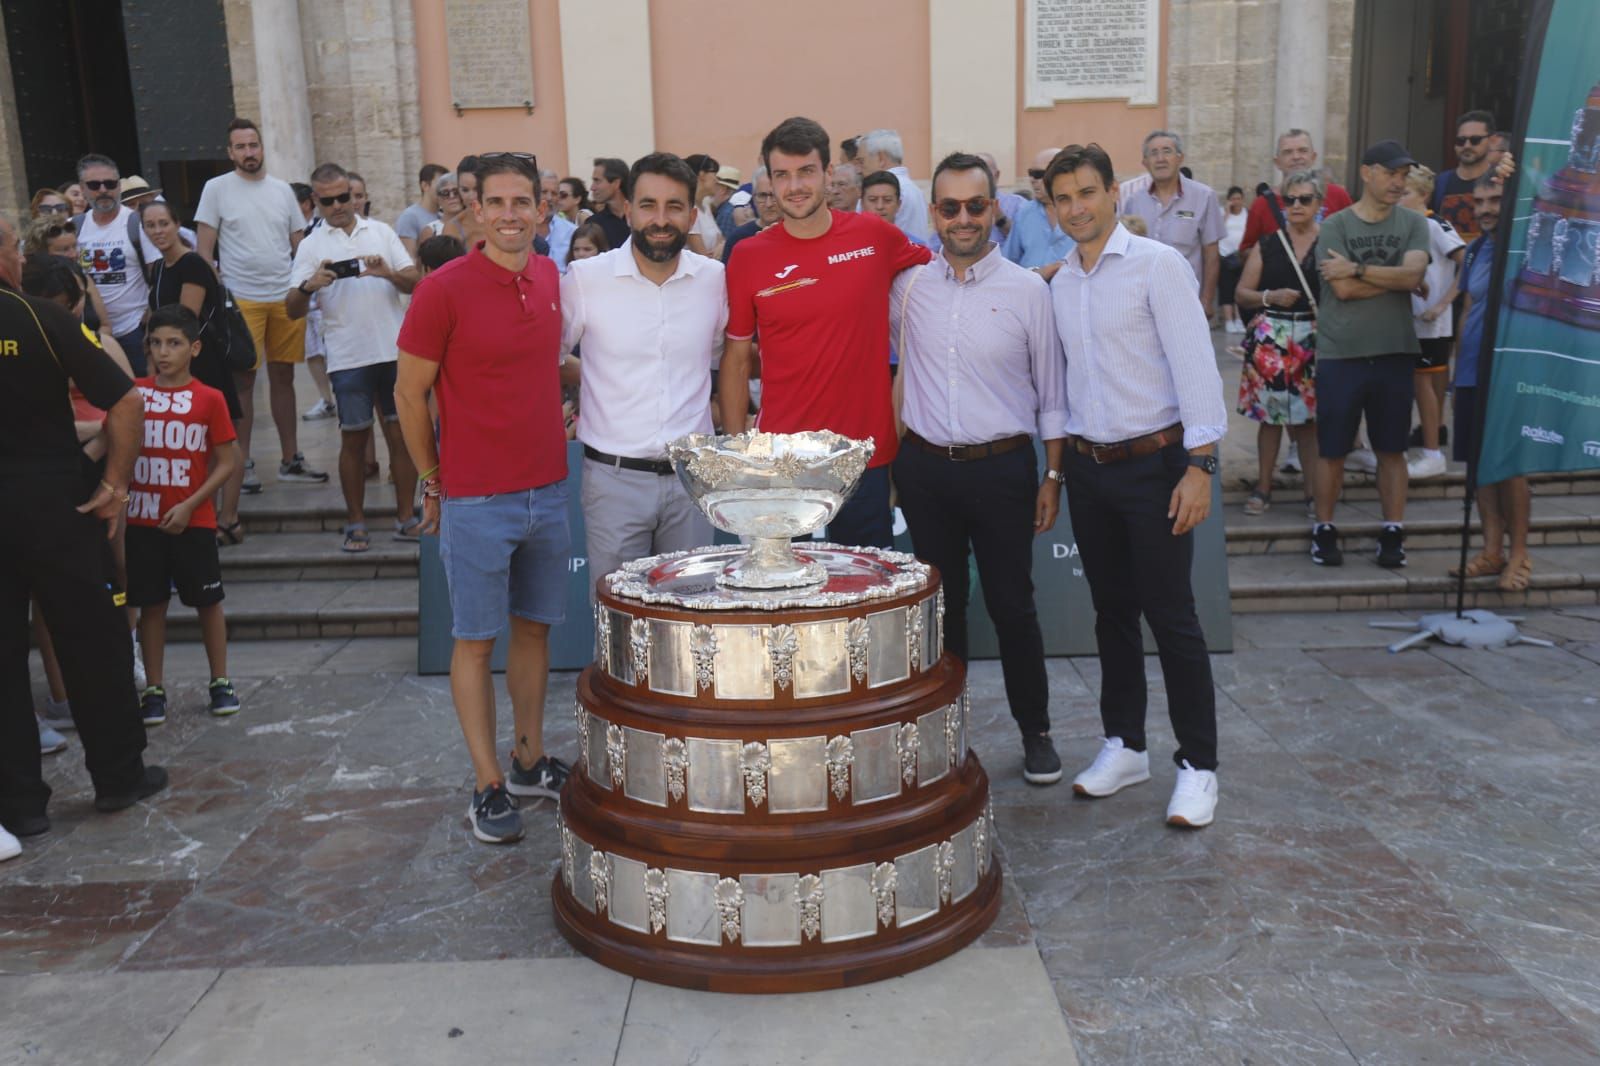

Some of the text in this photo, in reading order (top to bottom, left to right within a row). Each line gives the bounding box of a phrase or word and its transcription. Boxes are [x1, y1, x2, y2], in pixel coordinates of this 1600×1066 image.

[1350, 235, 1385, 249] ROUTE
[828, 246, 876, 265] MAPFRE
[0, 340, 19, 356] R
[137, 386, 193, 415] ESS
[143, 419, 208, 453] HOOL
[1521, 425, 1564, 444] Rakuten
[134, 455, 192, 488] ORE
[127, 490, 161, 520] UN
